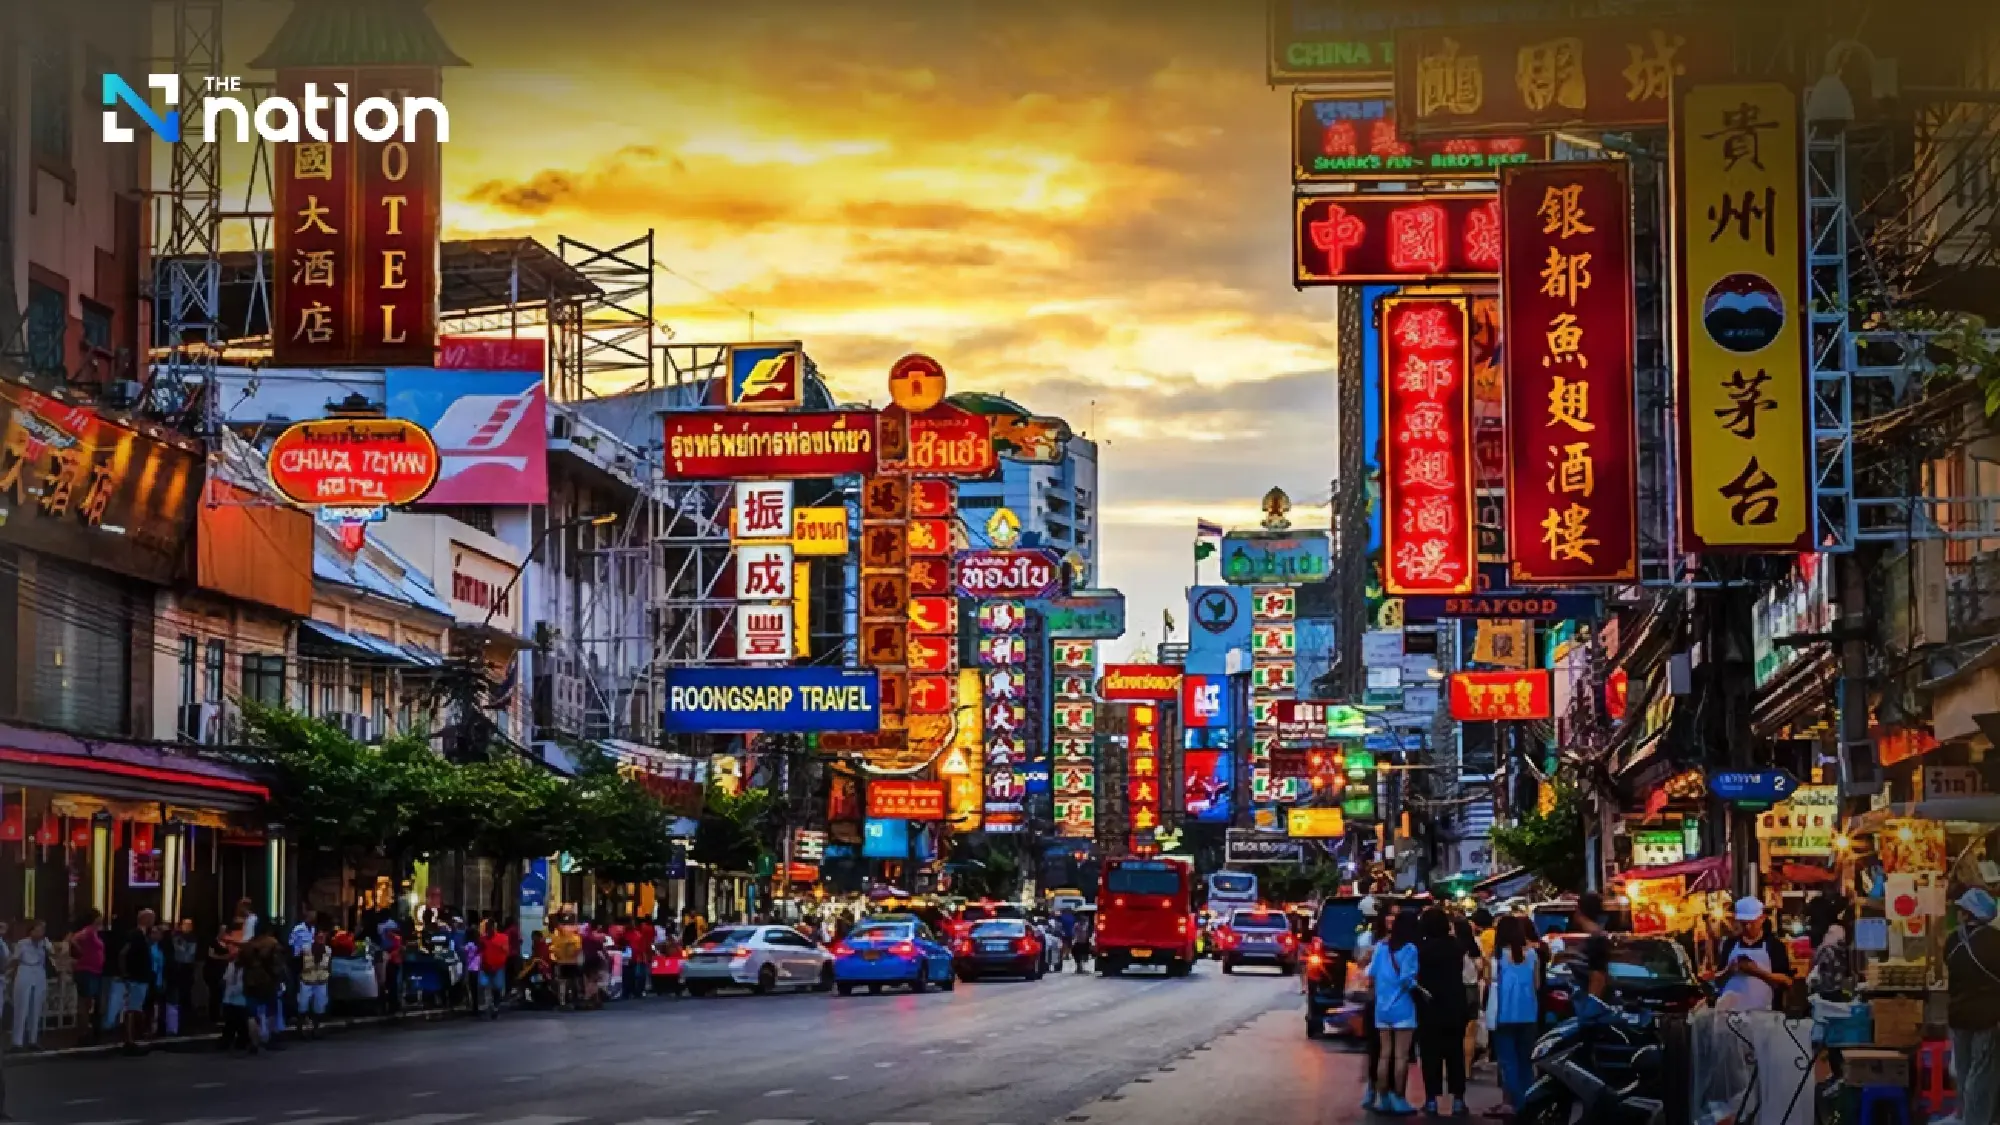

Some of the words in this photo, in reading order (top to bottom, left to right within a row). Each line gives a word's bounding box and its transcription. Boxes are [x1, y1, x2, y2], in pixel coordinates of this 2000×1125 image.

[1286, 43, 1370, 66] CHINA
[292, 97, 338, 345] 國大酒店
[1538, 184, 1601, 565] 銀都魚翅酒樓
[962, 557, 1049, 588] ทองใบ
[1445, 599, 1557, 614] SEAFOOD
[671, 686, 793, 711] ROONGSARP
[798, 686, 871, 711] TRAVEL
[1774, 776, 1785, 791] 2
